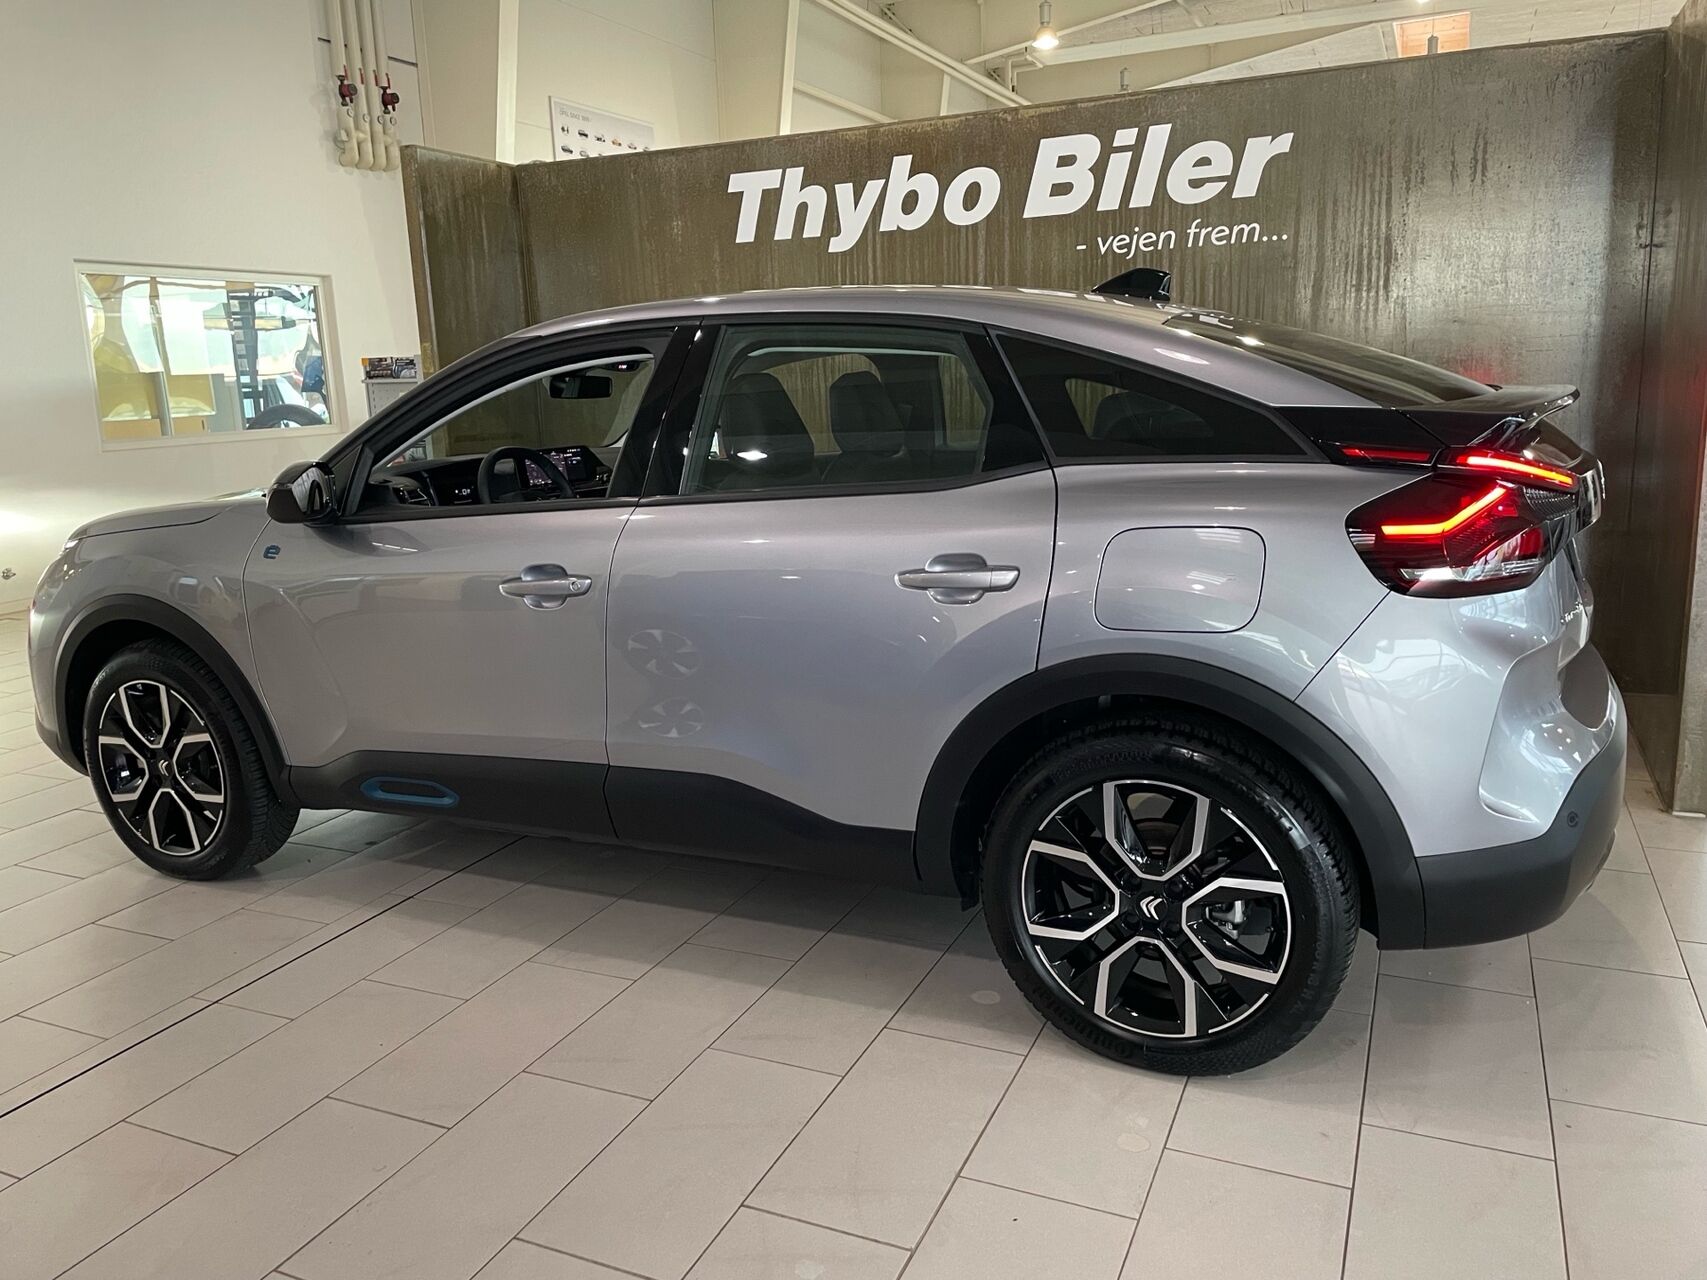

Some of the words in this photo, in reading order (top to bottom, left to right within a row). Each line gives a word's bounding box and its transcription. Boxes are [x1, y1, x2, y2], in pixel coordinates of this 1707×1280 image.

[727, 155, 1001, 253] Thybo
[1022, 123, 1294, 219] Biler
[1097, 226, 1177, 260] vejen
[1185, 218, 1289, 248] frem...
